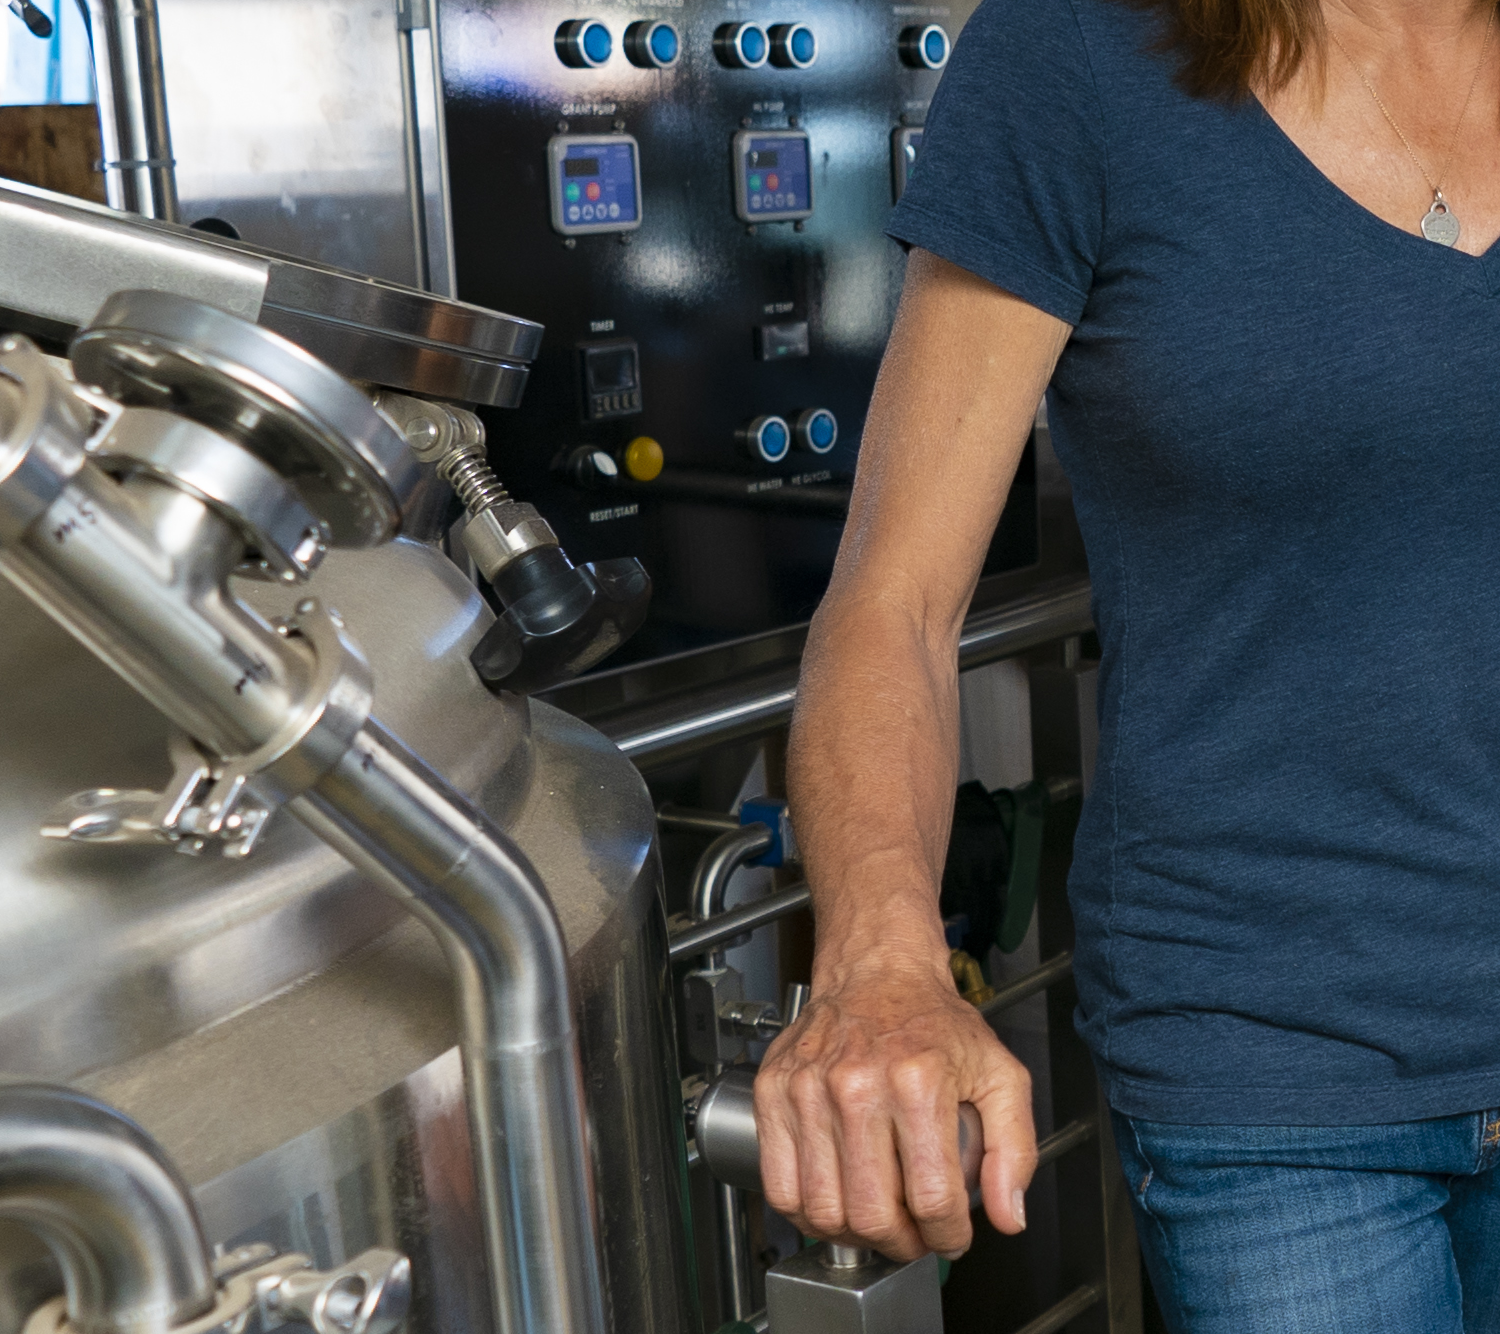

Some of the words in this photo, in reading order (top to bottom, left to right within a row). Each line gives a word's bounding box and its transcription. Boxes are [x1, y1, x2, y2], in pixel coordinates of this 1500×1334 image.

[777, 301, 795, 314] TEMP
[590, 319, 615, 333] TIMER
[760, 477, 784, 492] WATER
[589, 503, 640, 523] RESET/START
